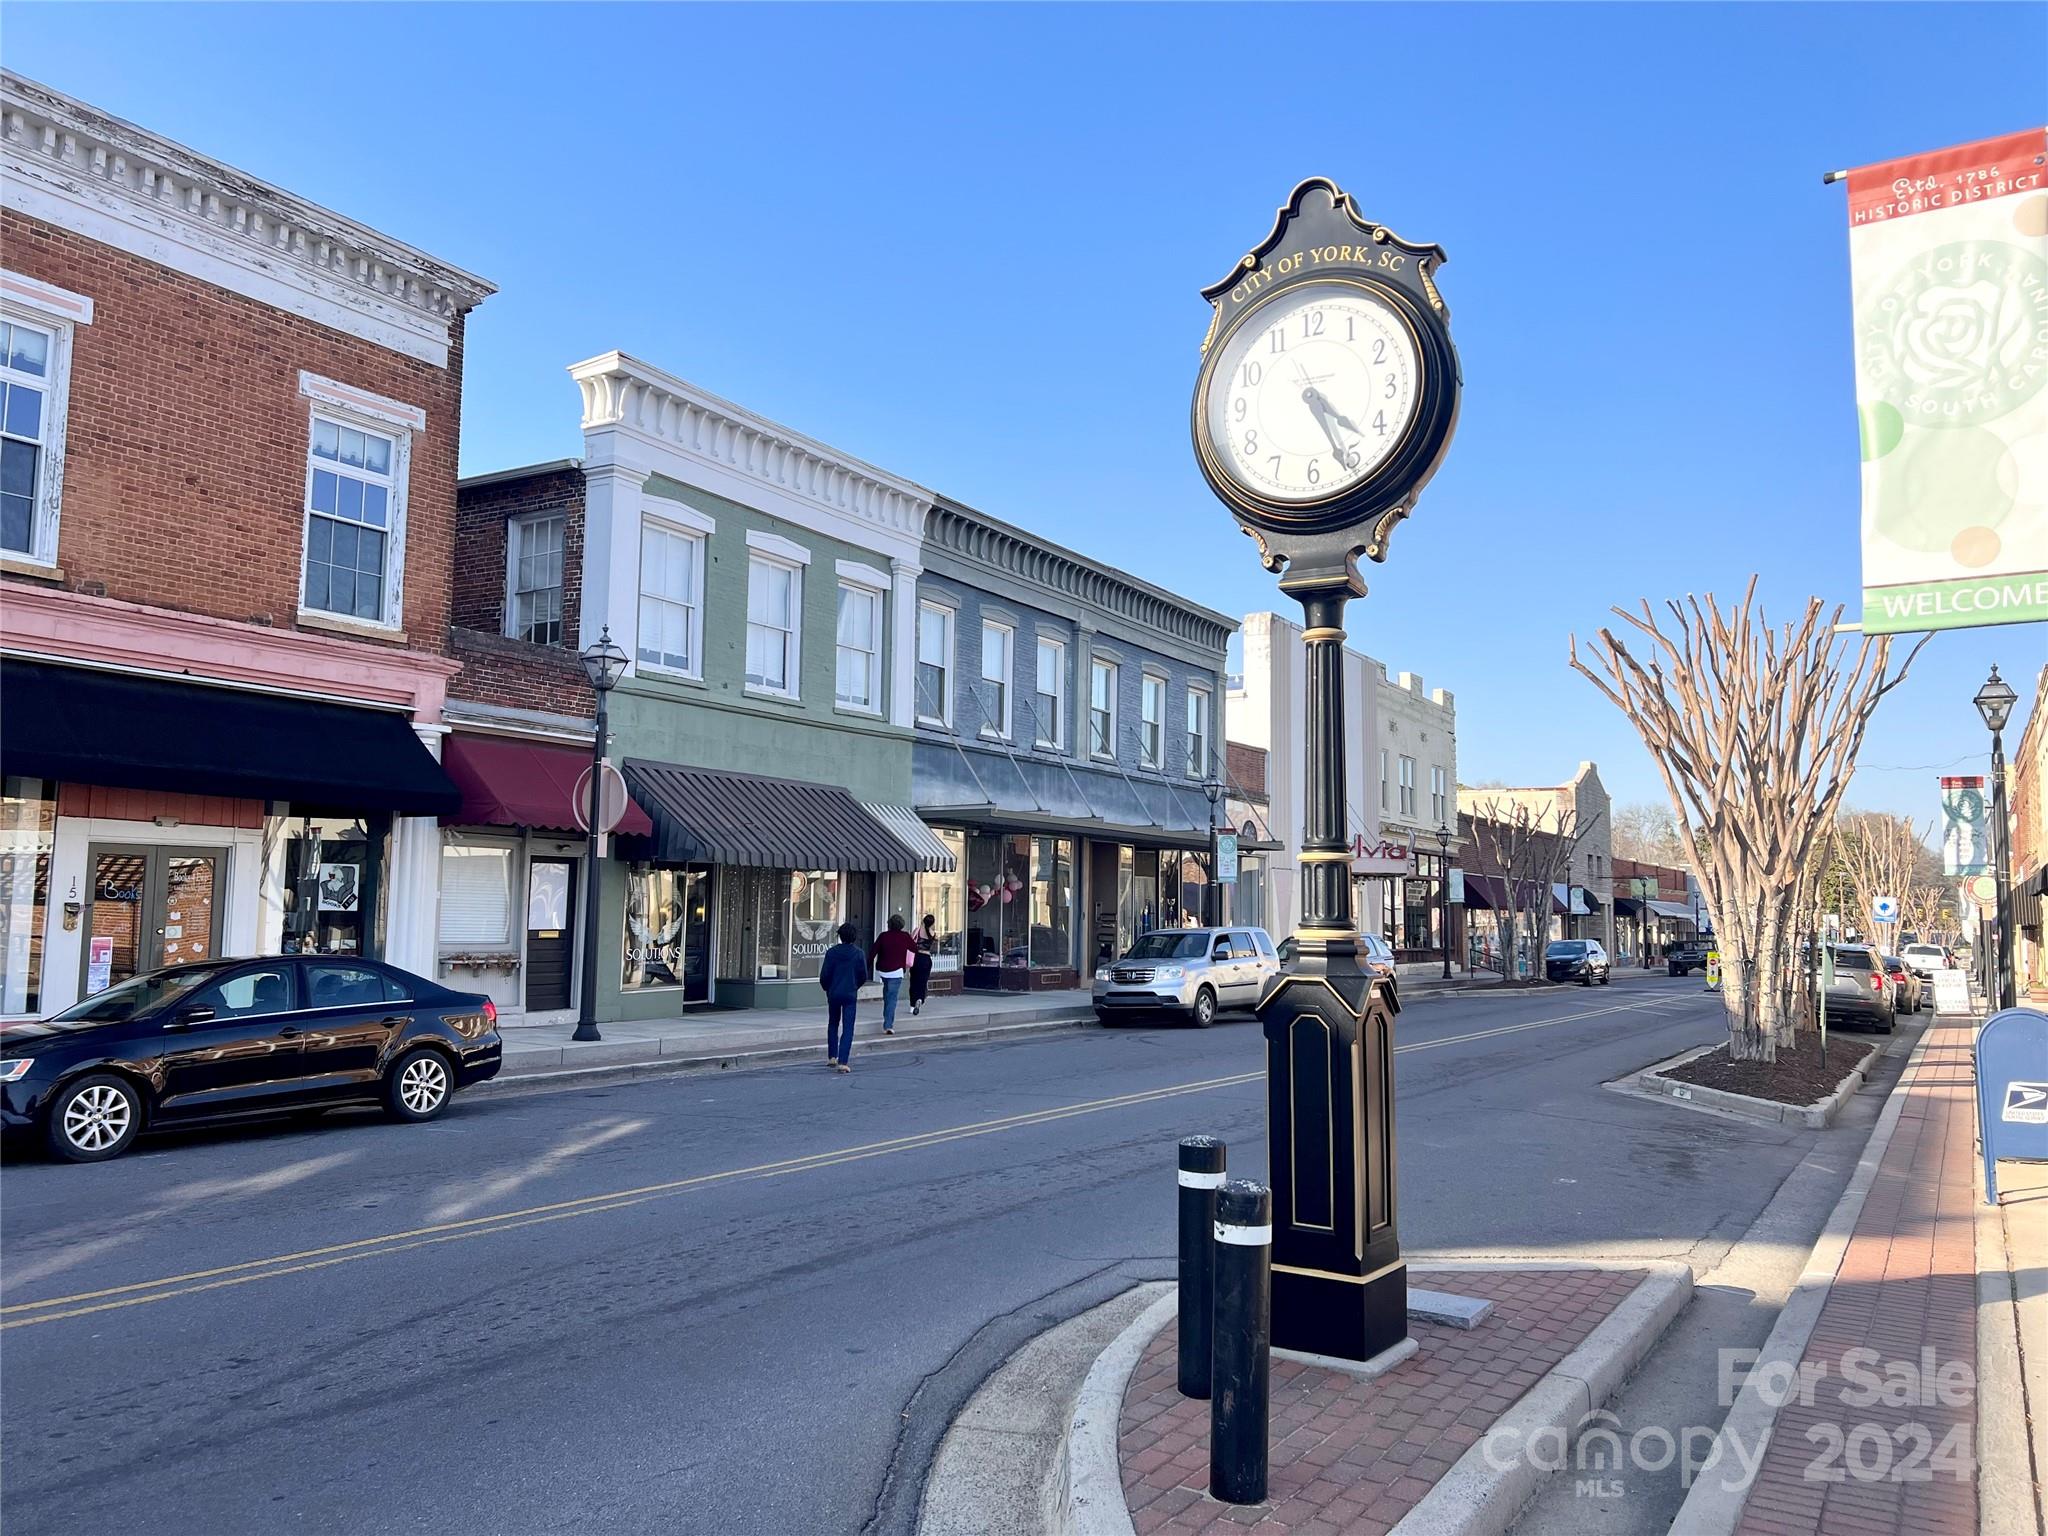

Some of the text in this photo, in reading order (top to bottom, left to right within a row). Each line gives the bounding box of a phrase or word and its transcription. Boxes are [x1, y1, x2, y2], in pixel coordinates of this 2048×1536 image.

[1892, 166, 2000, 200] Estd. 1786
[1855, 173, 2041, 222] HISTORIC DISTRICT
[1231, 245, 1406, 303] CITY OF YORK, SC
[1302, 311, 1326, 338] 12
[1346, 316, 1356, 342] 1
[1270, 328, 1287, 353] 11
[1372, 338, 1388, 365] 2
[1240, 361, 1262, 388] 10
[1384, 373, 1397, 399] 3
[1234, 397, 1247, 422] 9
[1372, 409, 1388, 436] 4
[1244, 429, 1258, 455] 8
[1345, 440, 1361, 469] 5
[1267, 455, 1281, 480] 7
[1307, 458, 1320, 484] 6
[1882, 582, 2048, 619] WELCOME
[104, 879, 141, 900] Books
[626, 946, 681, 961] SOLUTIONS
